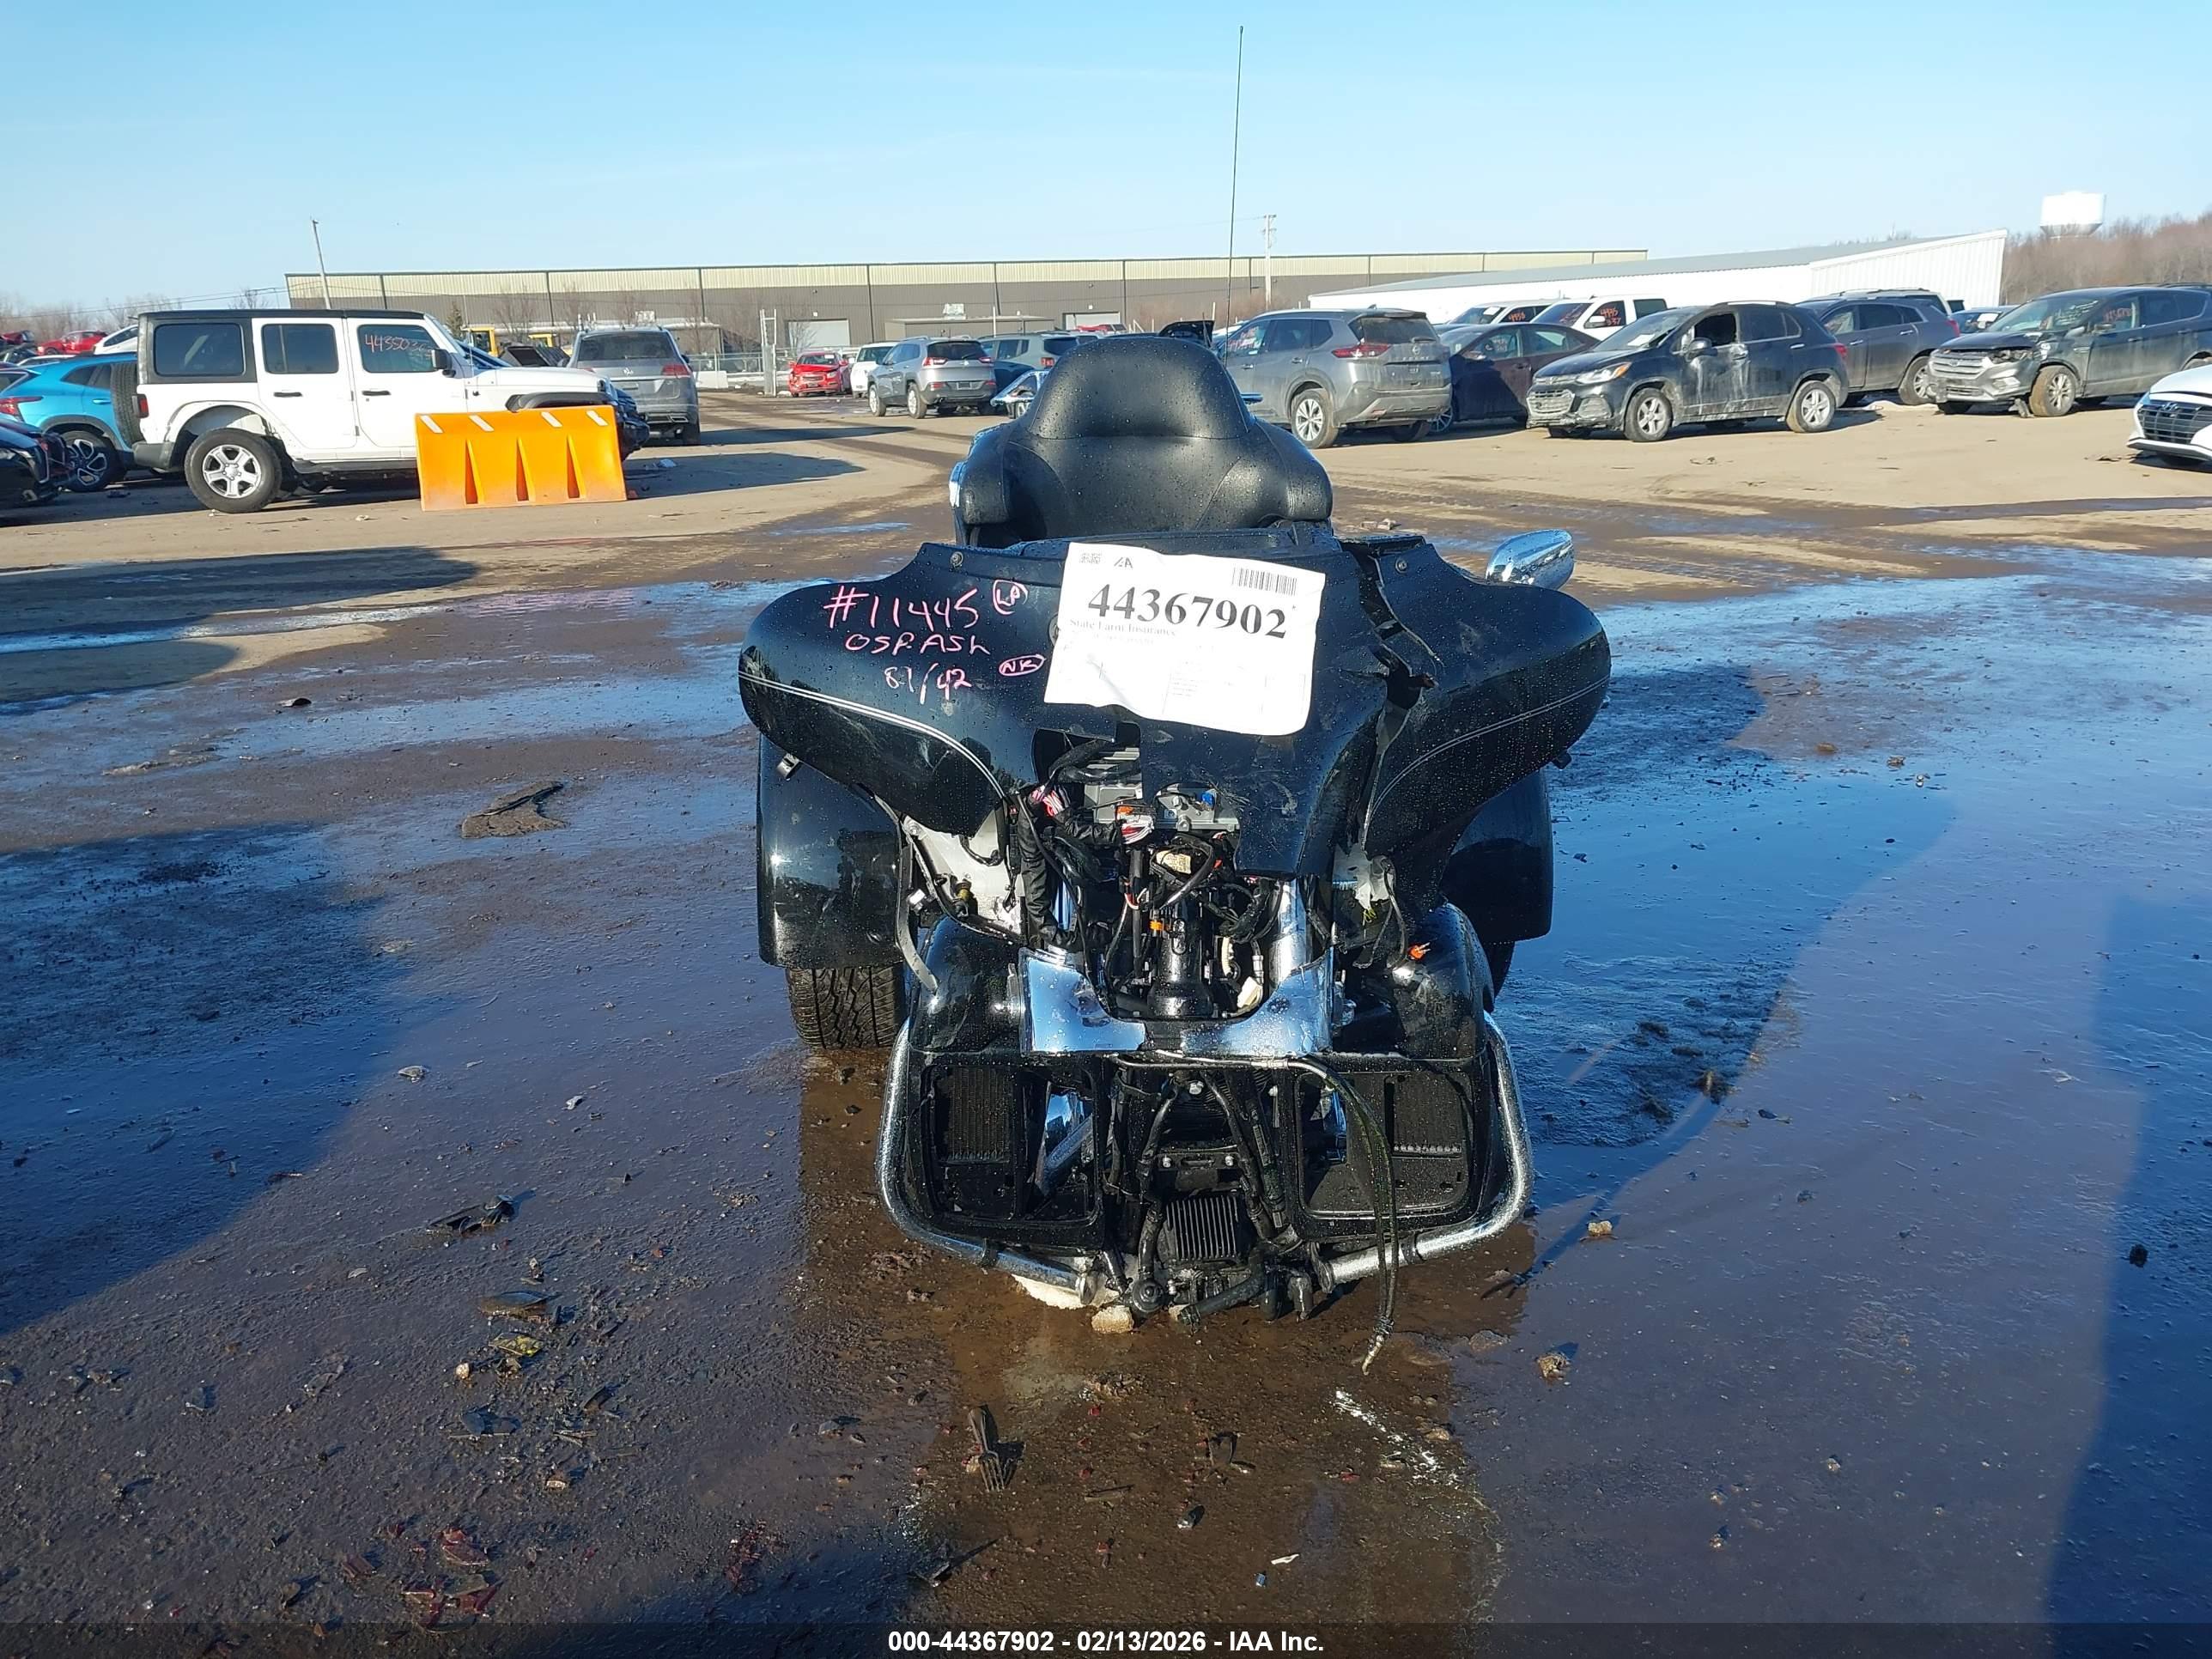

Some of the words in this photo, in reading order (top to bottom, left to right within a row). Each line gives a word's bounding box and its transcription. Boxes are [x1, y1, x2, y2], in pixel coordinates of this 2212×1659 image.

[823, 585, 978, 631] #11445
[1069, 618, 1095, 629] State
[1098, 621, 1125, 633] Farm
[1088, 584, 1287, 639] 44367902
